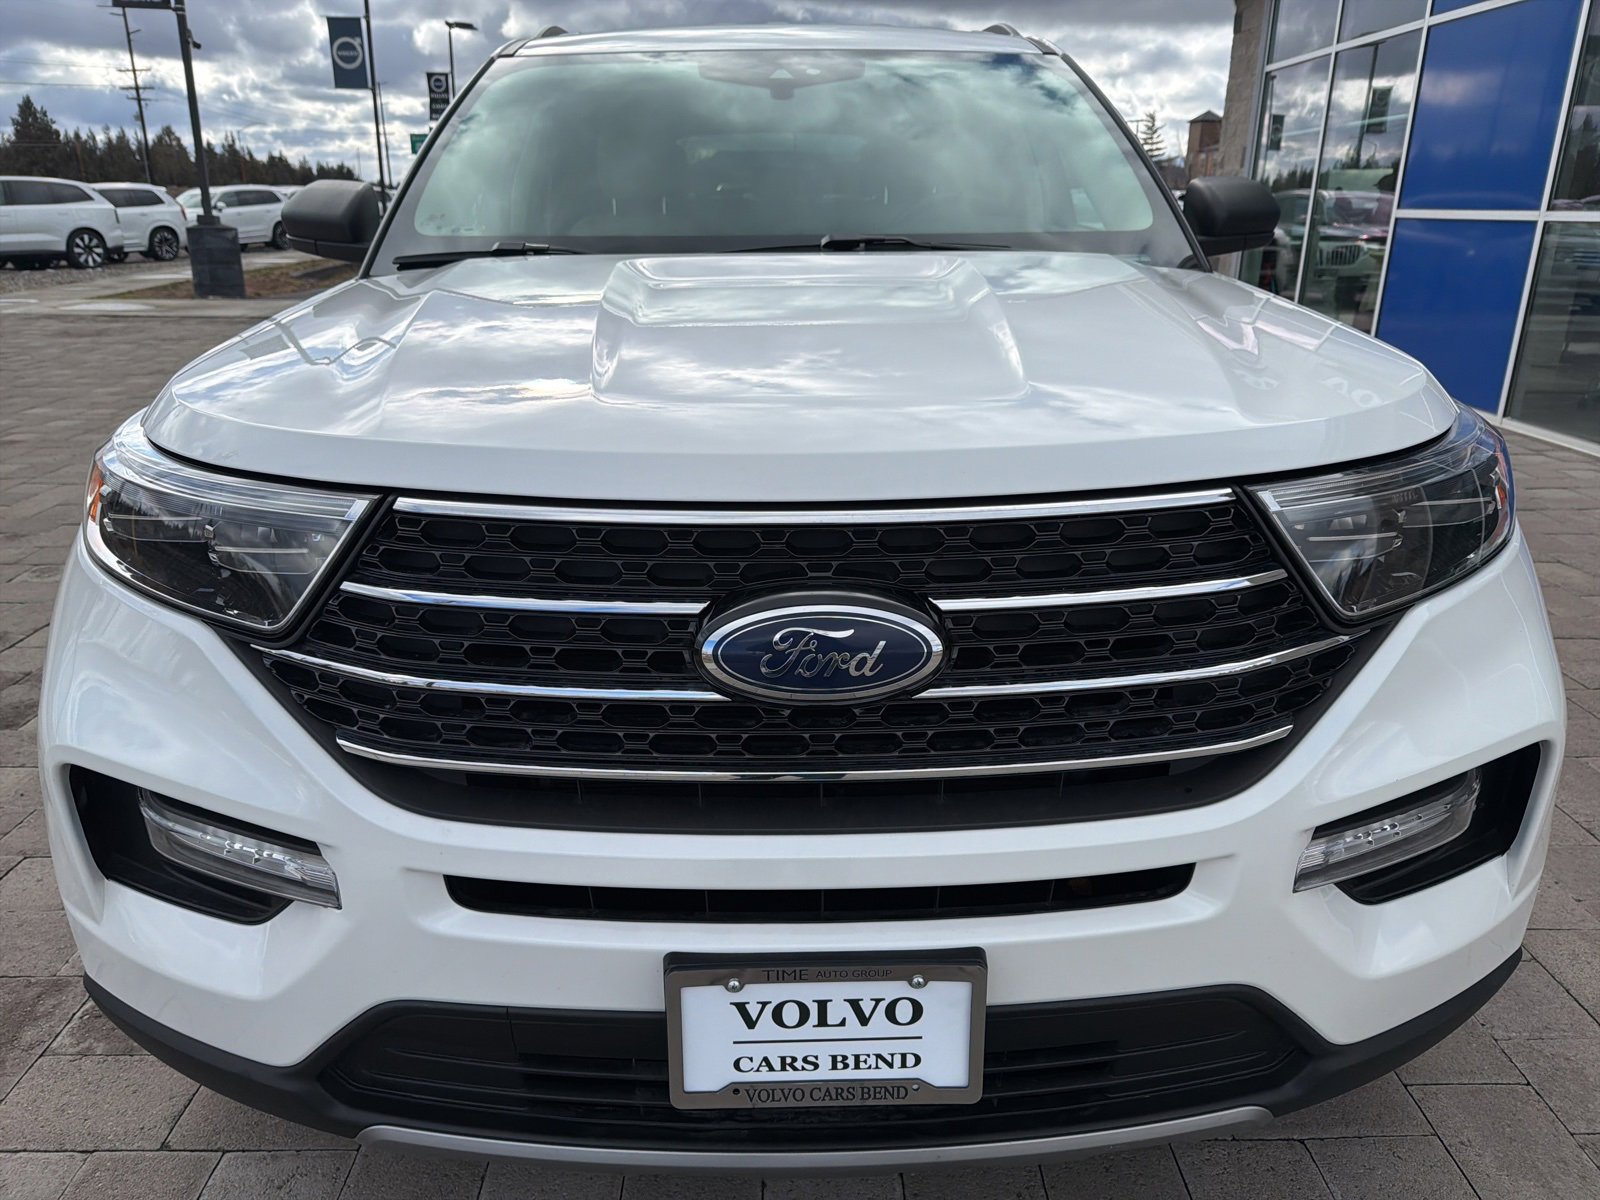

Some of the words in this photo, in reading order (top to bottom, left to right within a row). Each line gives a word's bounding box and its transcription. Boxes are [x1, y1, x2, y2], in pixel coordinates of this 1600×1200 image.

[760, 627, 886, 678] Ford
[761, 969, 809, 981] TIME
[815, 970, 849, 979] AUTO
[852, 969, 893, 978] GROUP
[729, 996, 924, 1030] VOLVO
[732, 1054, 820, 1073] CARS
[828, 1052, 922, 1071] BEND
[744, 1087, 805, 1104] VOLVO
[809, 1086, 856, 1102] CARS
[860, 1085, 908, 1101] BEND
